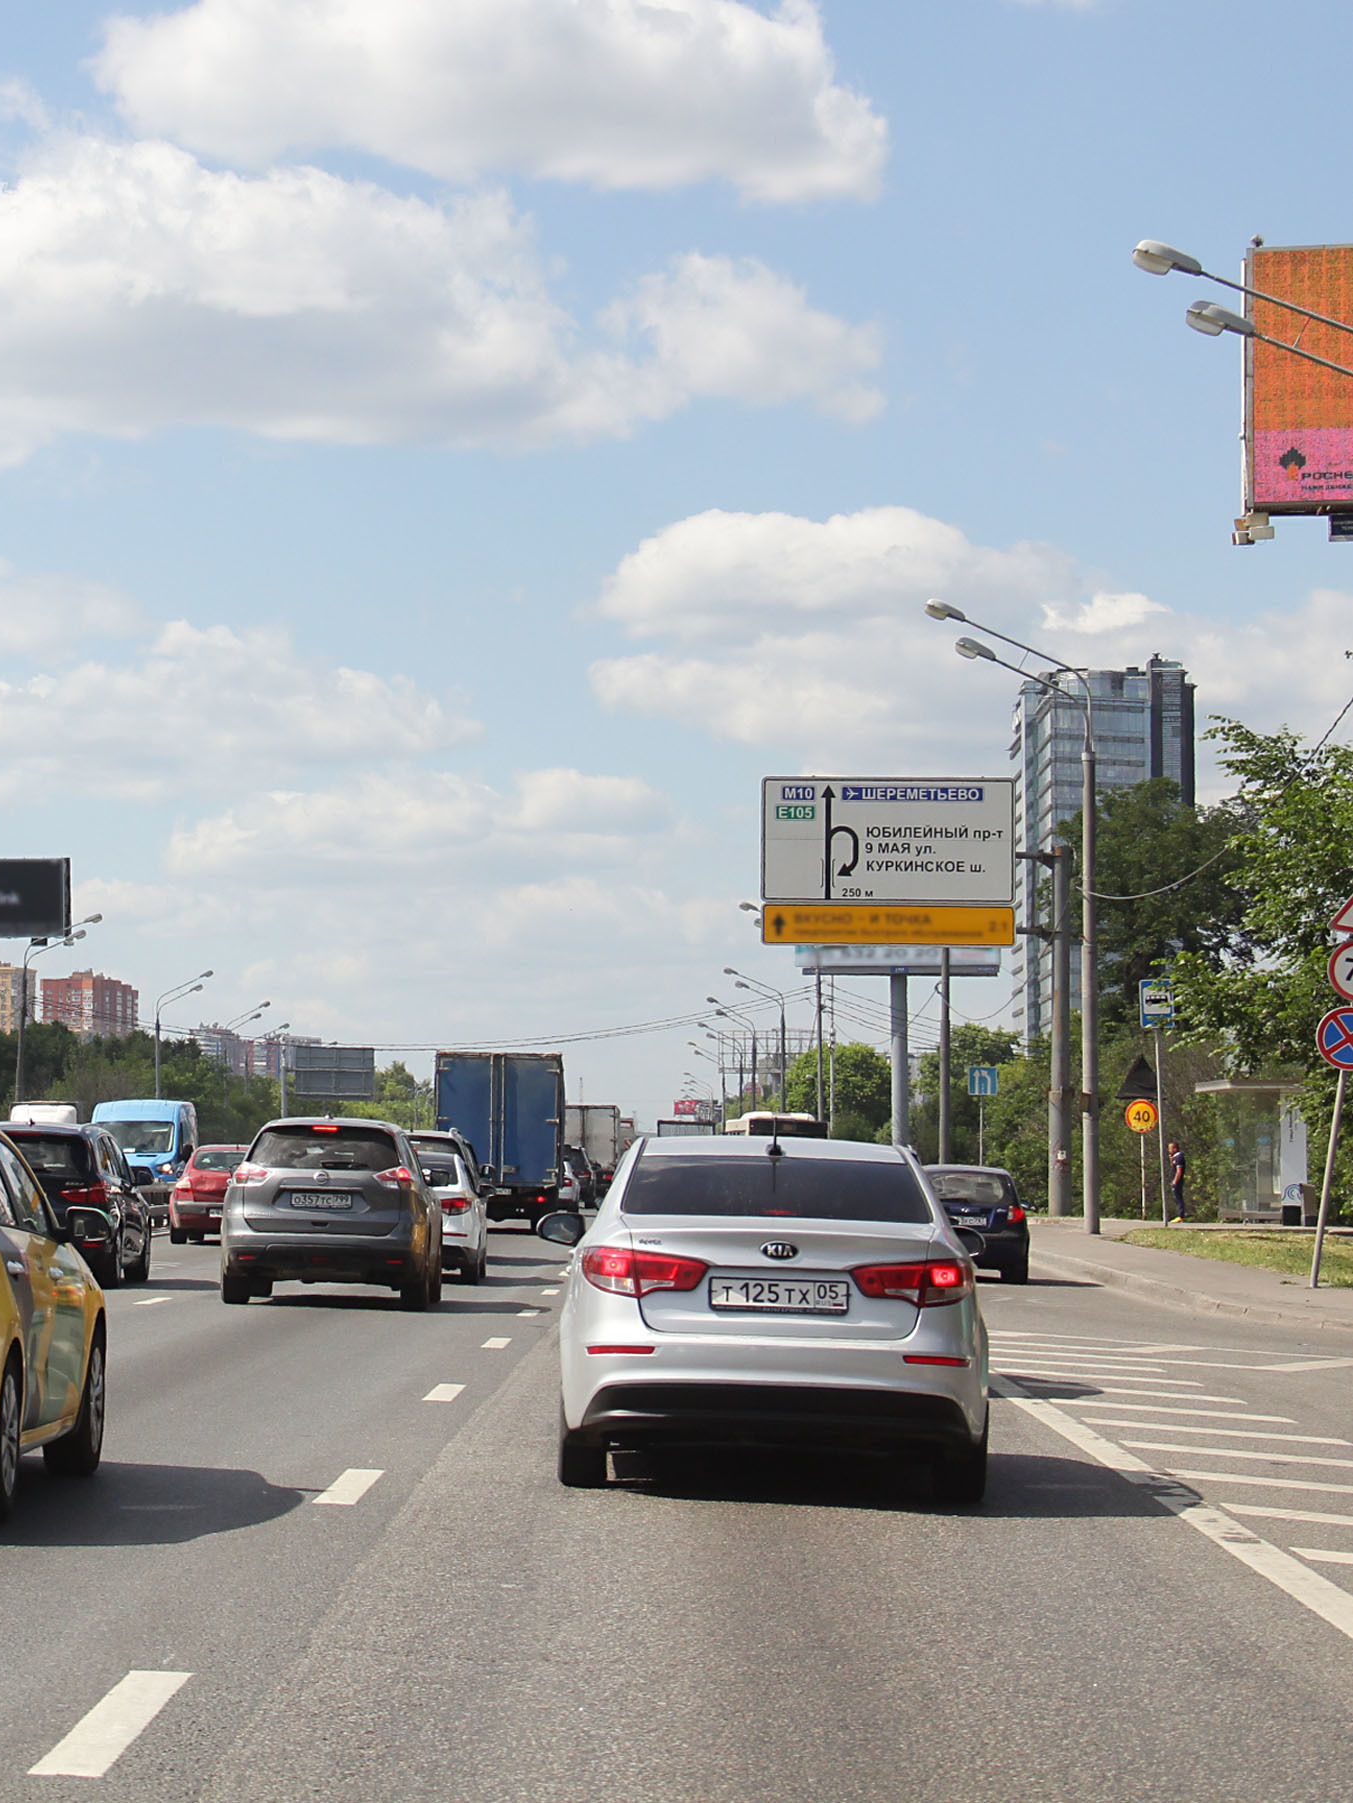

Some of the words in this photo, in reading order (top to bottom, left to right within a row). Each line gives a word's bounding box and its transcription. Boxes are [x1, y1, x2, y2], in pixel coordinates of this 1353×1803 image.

[861, 787, 980, 801] ШЕРЕМЕТЬЕВО
[866, 825, 969, 839] ЮБИЛЕЙНЫЙ
[973, 829, 1003, 841] пр-т
[865, 843, 873, 854] 9
[878, 843, 911, 854] МАЯ
[915, 845, 936, 856] ул.
[866, 861, 965, 872] КУРКИНСКОЕ
[970, 864, 986, 873] ш.
[842, 888, 861, 897] 250
[1134, 1111, 1150, 1122] 40
[767, 1244, 794, 1257] KIA
[817, 1284, 839, 1299] 05
